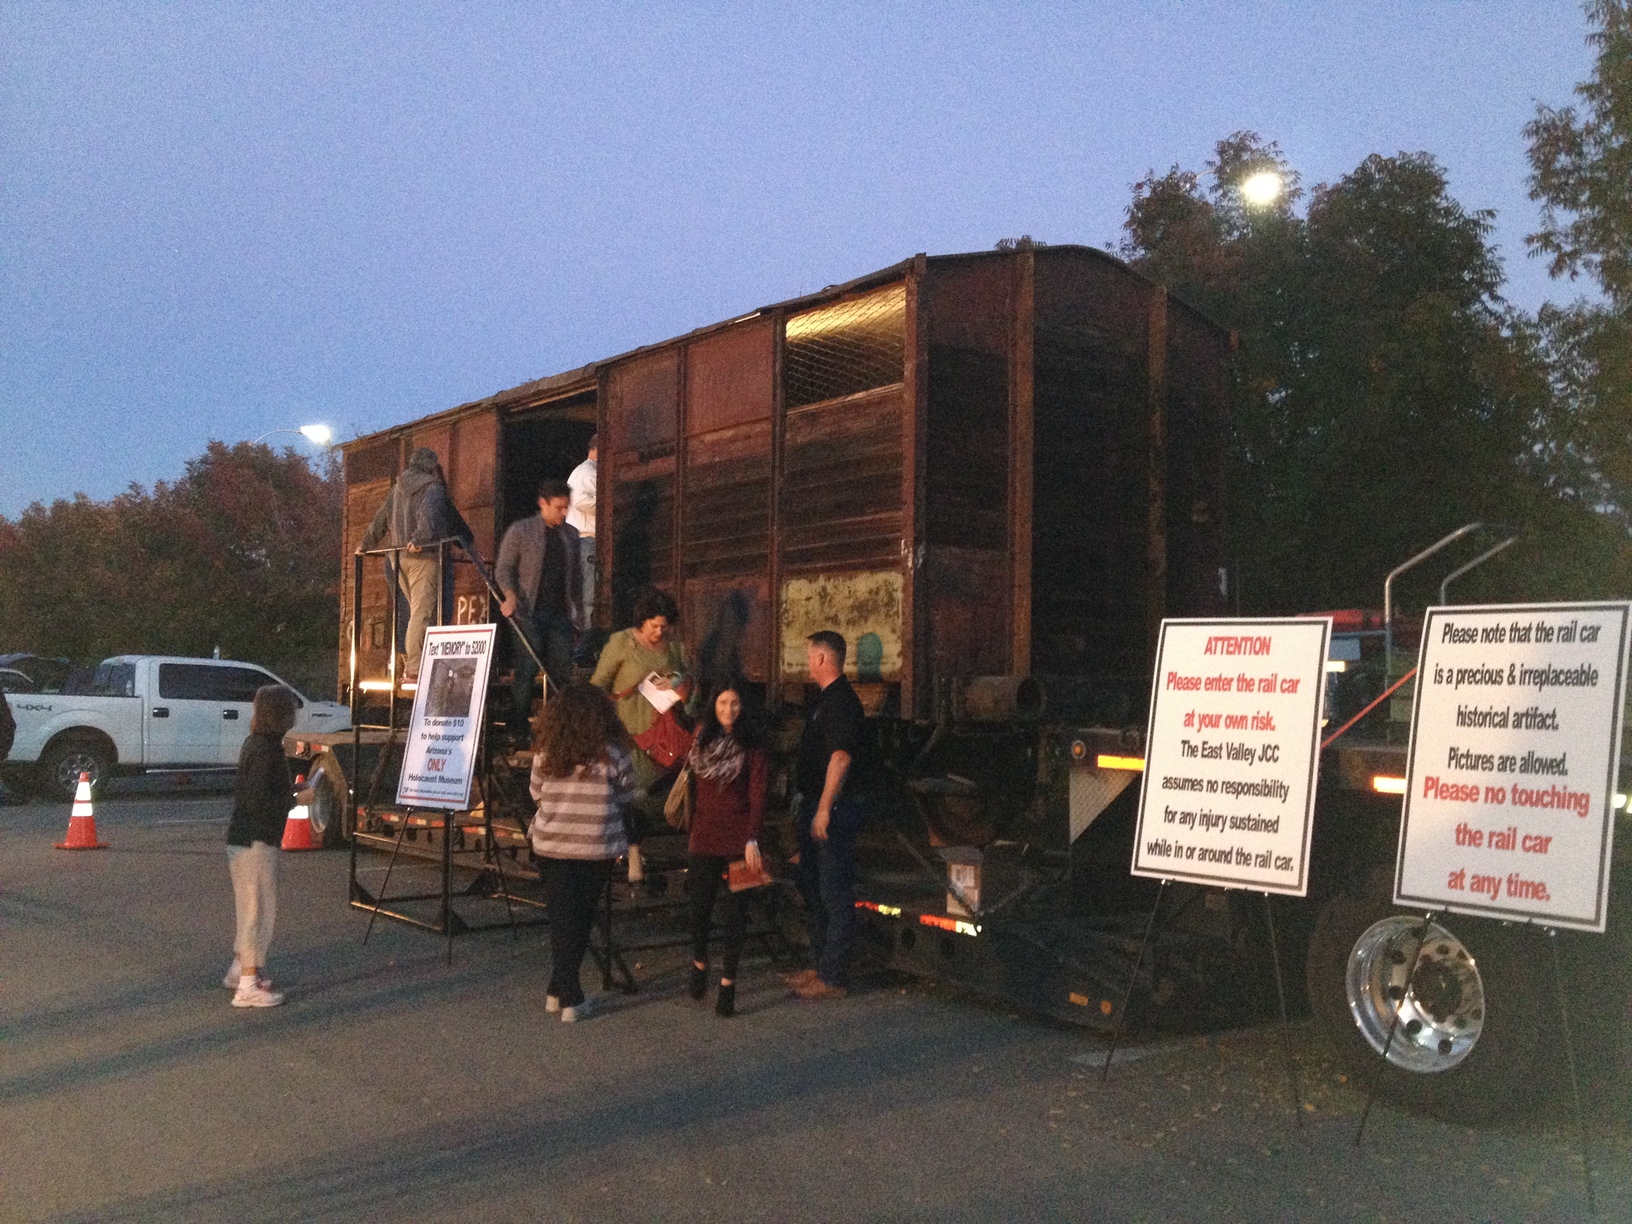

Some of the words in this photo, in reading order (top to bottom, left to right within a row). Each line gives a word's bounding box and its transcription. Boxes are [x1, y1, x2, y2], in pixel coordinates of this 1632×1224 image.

[1442, 623, 1478, 644] Please
[1480, 623, 1506, 644] note
[1509, 622, 1532, 644] that
[1535, 621, 1554, 644] the
[1557, 620, 1578, 644] rail
[1580, 625, 1602, 644] car
[428, 642, 439, 656] Text
[465, 642, 470, 655] to
[1204, 636, 1272, 656] ATTENTION
[1166, 672, 1202, 691] Please
[1204, 674, 1234, 692] enter
[1236, 673, 1254, 692] the
[1258, 673, 1278, 693] rail
[1280, 678, 1300, 694] car
[1434, 663, 1444, 685] is
[1446, 670, 1453, 685] a
[1455, 663, 1504, 690] precious
[1507, 663, 1516, 685] &
[1519, 663, 1598, 692] irreplaceable
[424, 718, 431, 727] To
[432, 718, 452, 727] donate
[453, 719, 464, 728] $10
[1184, 709, 1195, 727] at
[1197, 714, 1222, 732] your
[1224, 715, 1248, 730] own
[1251, 711, 1276, 731] risk.
[1456, 705, 1510, 728] historical
[1512, 707, 1559, 731] artifact.
[428, 733, 440, 742] help
[441, 734, 464, 742] support
[426, 746, 452, 756] Arizona's
[1181, 740, 1198, 758] The
[1201, 741, 1223, 760] East
[1226, 742, 1256, 766] Valley
[1258, 744, 1280, 763] JCC
[1448, 746, 1494, 772] Pictures
[1497, 755, 1516, 772] are
[1519, 751, 1568, 776] allowed.
[427, 758, 447, 772] ONLY
[408, 773, 438, 782] Holocaust
[438, 775, 463, 784] Museum
[1162, 776, 1204, 792] assumes
[1206, 780, 1218, 793] no
[1220, 778, 1290, 804] responsibility
[1424, 776, 1480, 803] Please
[1484, 786, 1506, 804] no
[1511, 783, 1590, 818] touching
[1164, 805, 1178, 824] for
[1178, 810, 1198, 830] any
[1198, 809, 1228, 832] injury
[1229, 814, 1280, 834] sustained
[1455, 822, 1484, 846] the
[1487, 826, 1517, 850] rail
[1522, 834, 1553, 854] car
[1147, 838, 1172, 857] while
[1174, 840, 1183, 858] in
[1186, 846, 1196, 858] or
[1198, 846, 1233, 865] around
[1235, 846, 1252, 866] the
[1254, 850, 1272, 868] rail
[1274, 856, 1294, 872] car.
[1448, 867, 1465, 890] at
[1470, 874, 1502, 900] any
[1506, 872, 1550, 901] time.
